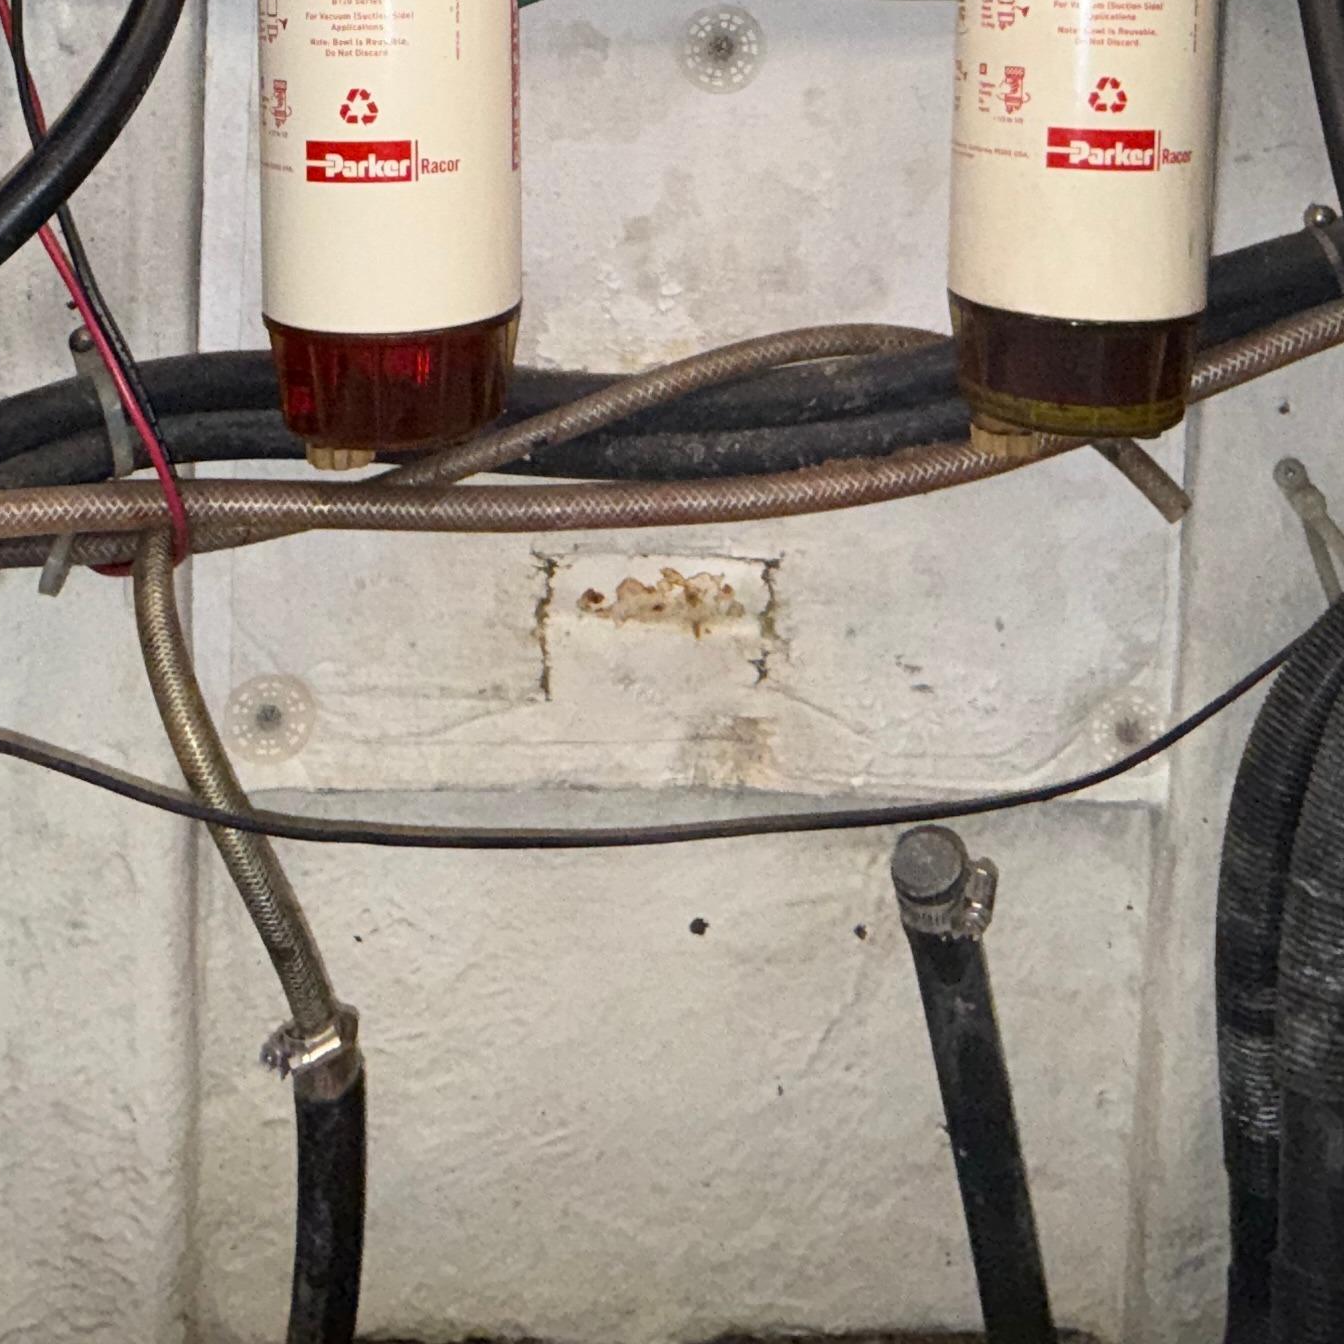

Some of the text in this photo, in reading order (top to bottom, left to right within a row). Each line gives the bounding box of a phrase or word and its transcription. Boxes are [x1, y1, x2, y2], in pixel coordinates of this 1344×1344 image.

[1054, 0, 1067, 8] For
[319, 12, 351, 20] Vacuum
[331, 24, 384, 32] Applications
[338, 49, 352, 57] Not
[1069, 140, 1192, 165] Parker Racor
[325, 153, 461, 178] Parker Racor
